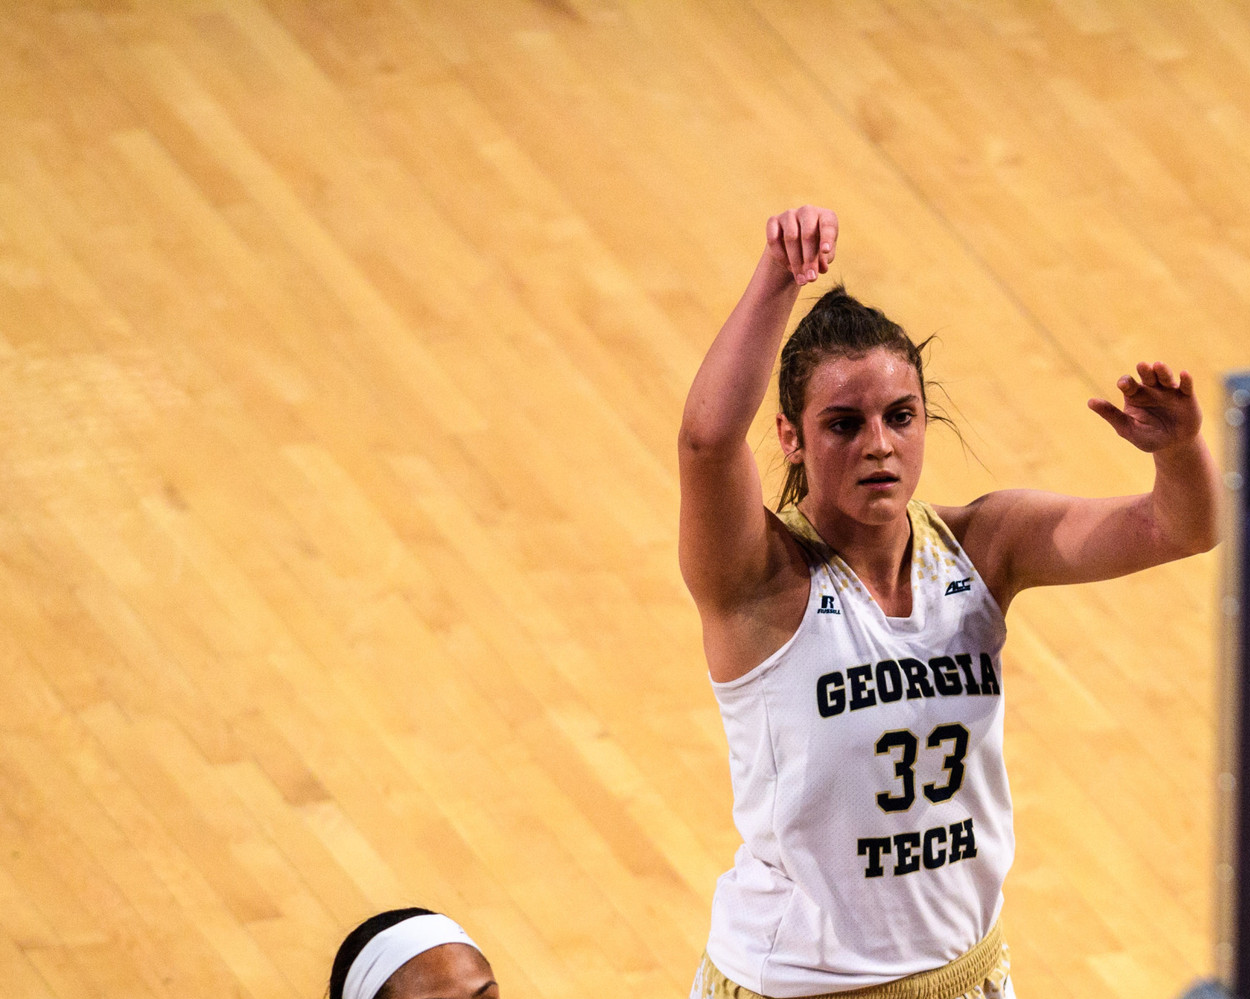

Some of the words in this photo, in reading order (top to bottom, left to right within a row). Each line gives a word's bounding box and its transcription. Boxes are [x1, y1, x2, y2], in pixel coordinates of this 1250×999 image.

[816, 652, 1001, 719] GEORGIA
[873, 721, 971, 815] 33
[857, 817, 978, 879] TECH
